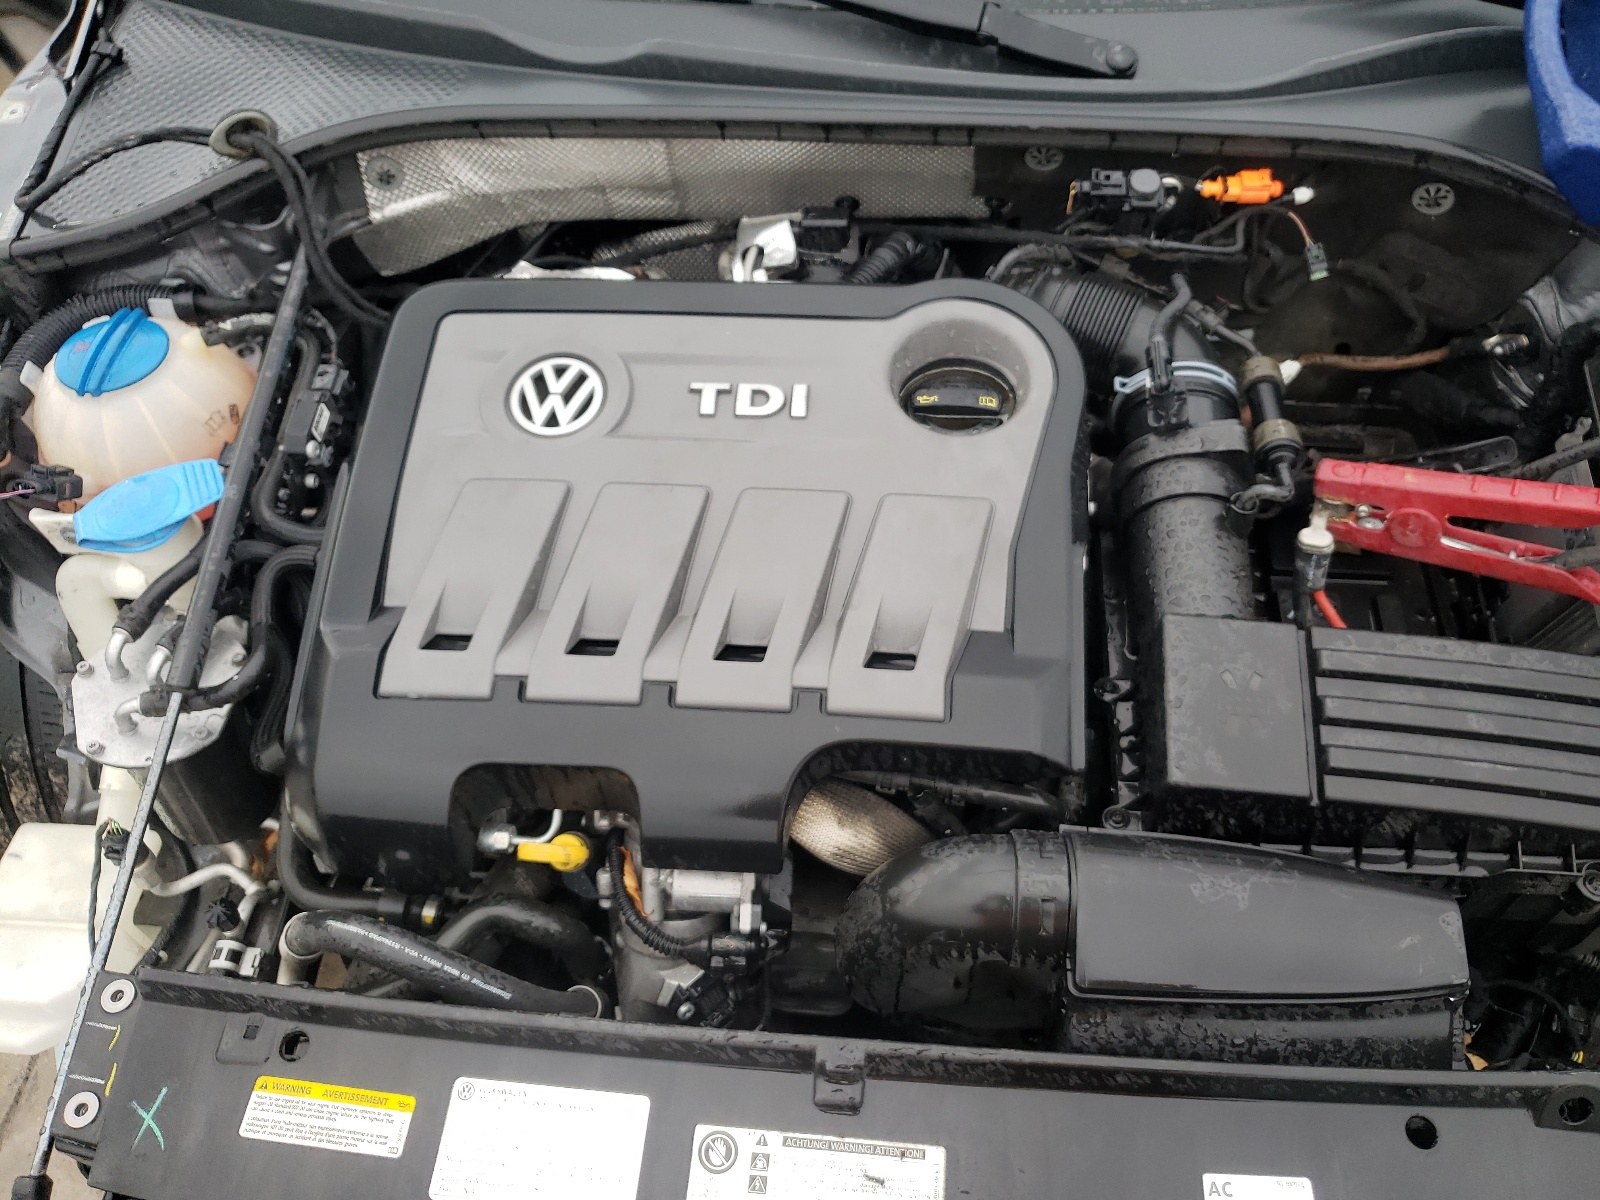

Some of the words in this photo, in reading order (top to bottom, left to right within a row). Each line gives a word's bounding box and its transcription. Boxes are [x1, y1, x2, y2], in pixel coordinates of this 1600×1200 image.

[688, 380, 809, 419] TDI
[272, 1082, 312, 1095] WARNING
[322, 1089, 390, 1106] AVERTISSEMENT
[785, 1137, 829, 1150] ACHTUNG!
[831, 1142, 874, 1154] WARNING!
[1208, 1181, 1233, 1198] AC
